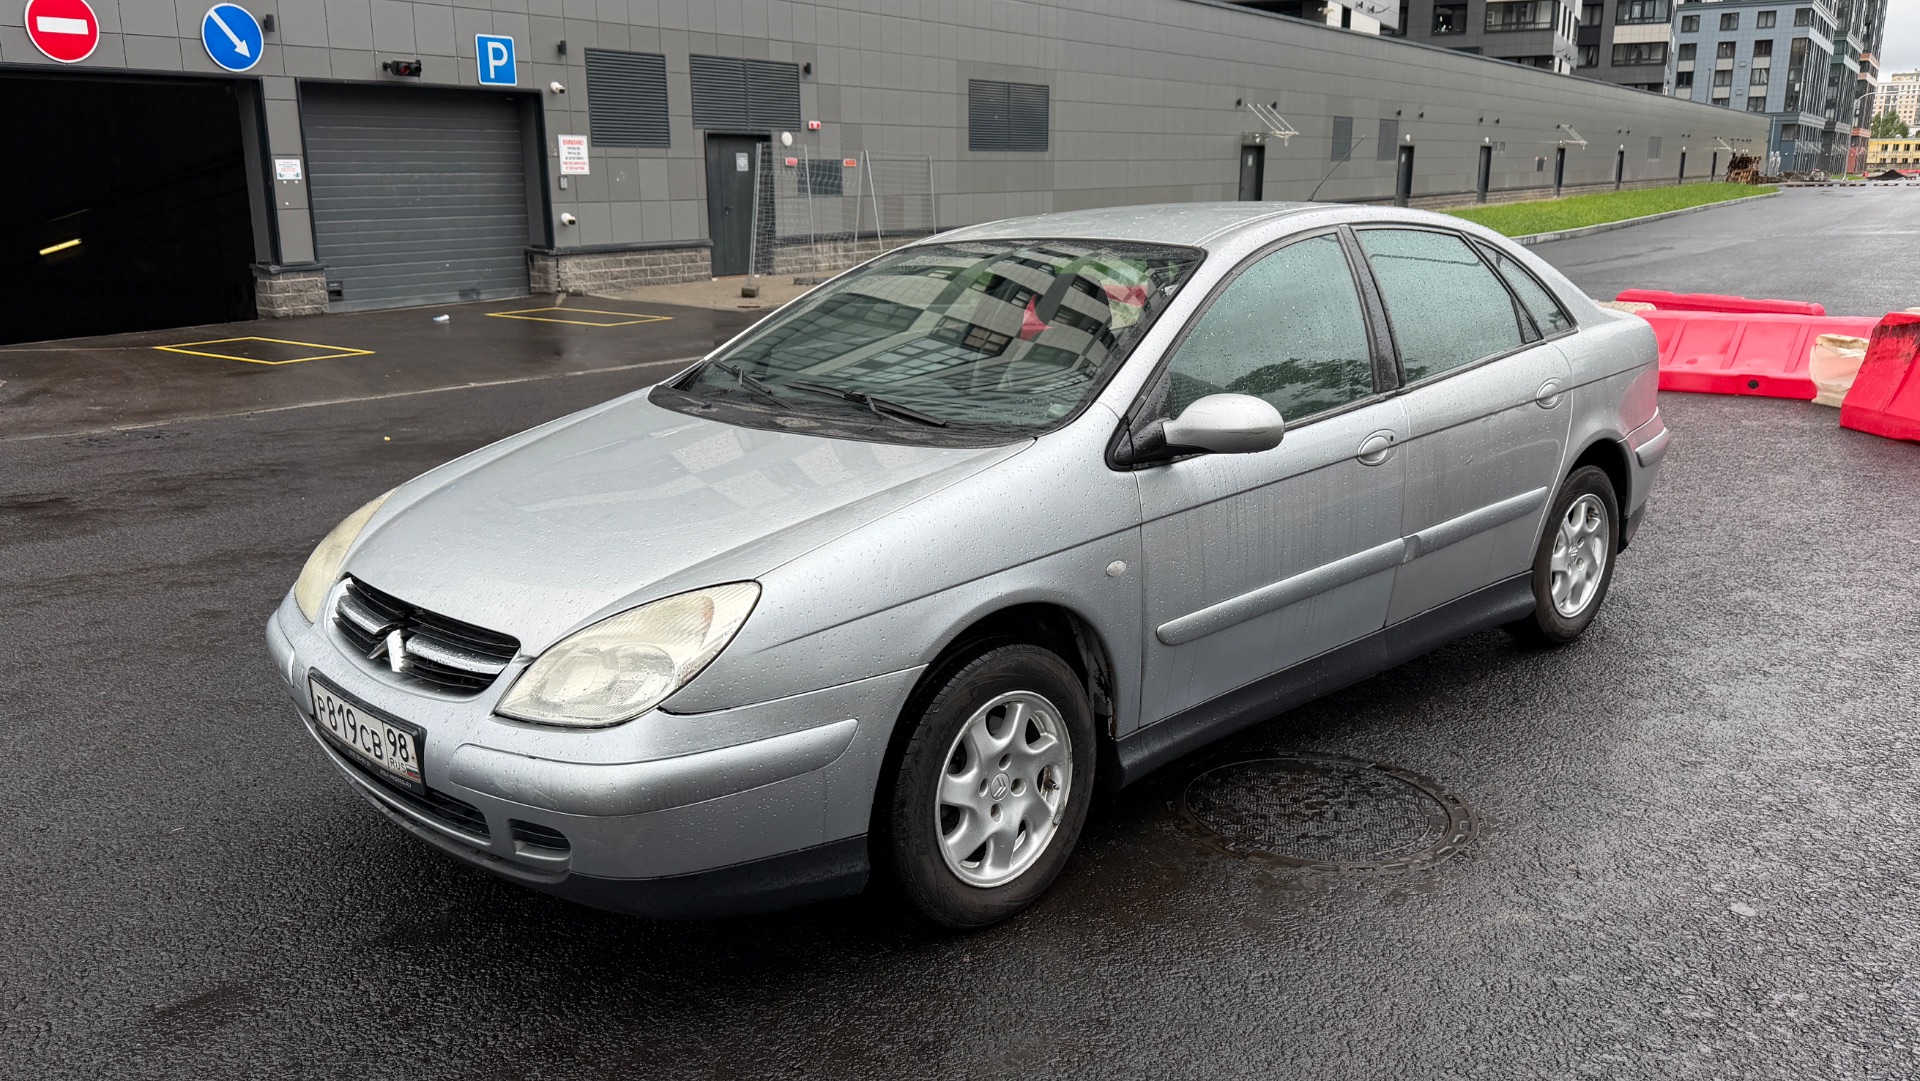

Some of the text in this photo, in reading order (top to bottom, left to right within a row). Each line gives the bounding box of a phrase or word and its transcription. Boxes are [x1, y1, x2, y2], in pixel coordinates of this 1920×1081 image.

[487, 41, 509, 79] P
[387, 728, 409, 762] 98
[389, 757, 407, 773] RUS
